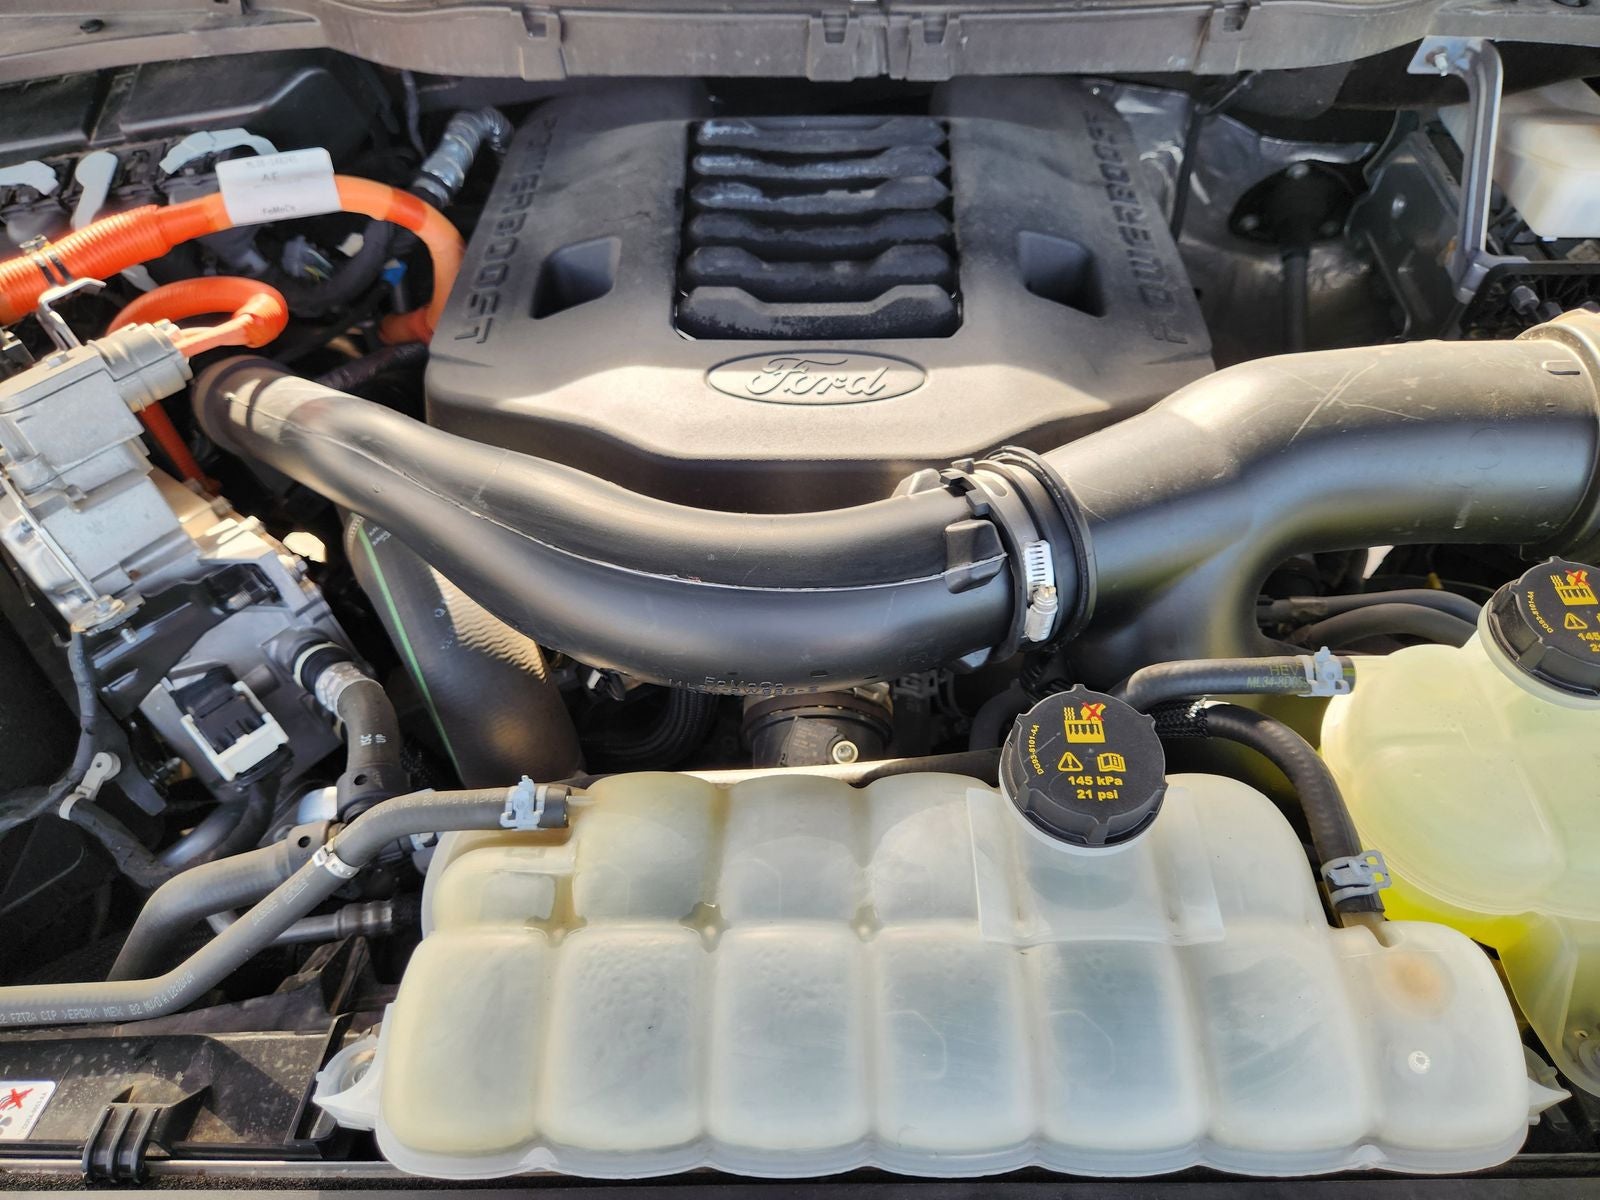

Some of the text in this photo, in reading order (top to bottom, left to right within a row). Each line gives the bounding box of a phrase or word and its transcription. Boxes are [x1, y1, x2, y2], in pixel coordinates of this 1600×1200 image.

[745, 357, 890, 396] Ford
[1590, 643, 1600, 652] 2
[1269, 664, 1299, 676] HEV
[1068, 775, 1124, 786] 145 kPa
[1076, 789, 1119, 802] 21 psi
